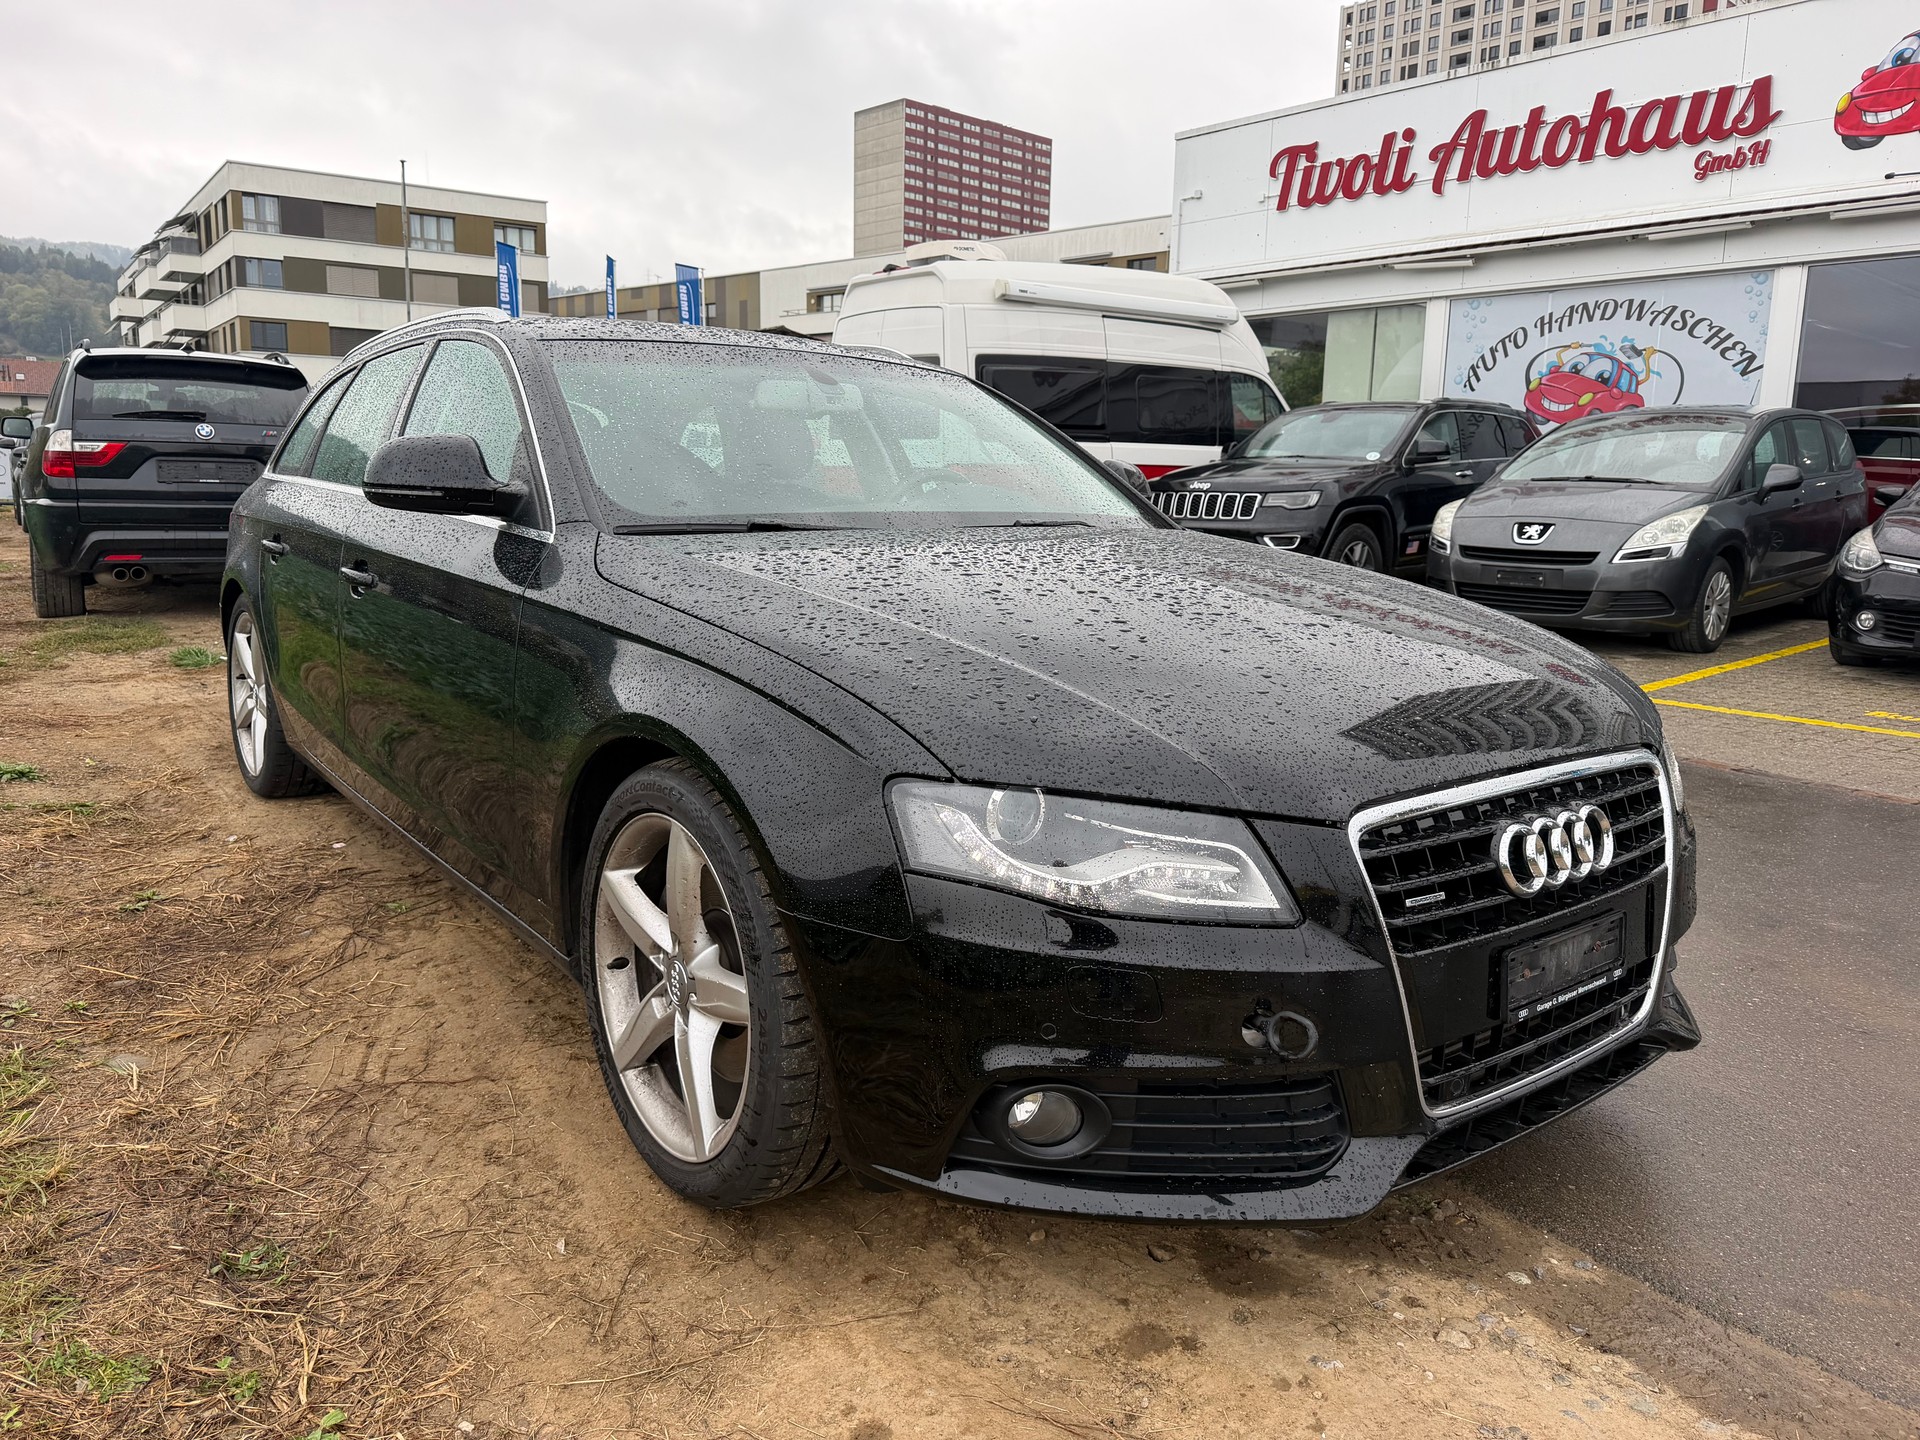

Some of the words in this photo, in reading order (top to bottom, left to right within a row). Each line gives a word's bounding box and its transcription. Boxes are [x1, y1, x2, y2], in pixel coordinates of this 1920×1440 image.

[1269, 127, 1418, 213] Tivoli
[1428, 74, 1784, 197] Autohaus
[1693, 138, 1772, 182] GmbH
[1464, 326, 1529, 392] AUTO
[1533, 298, 1764, 379] HANDWASCHEN
[1189, 480, 1212, 491] Jeep
[1536, 1000, 1553, 1012] Garage
